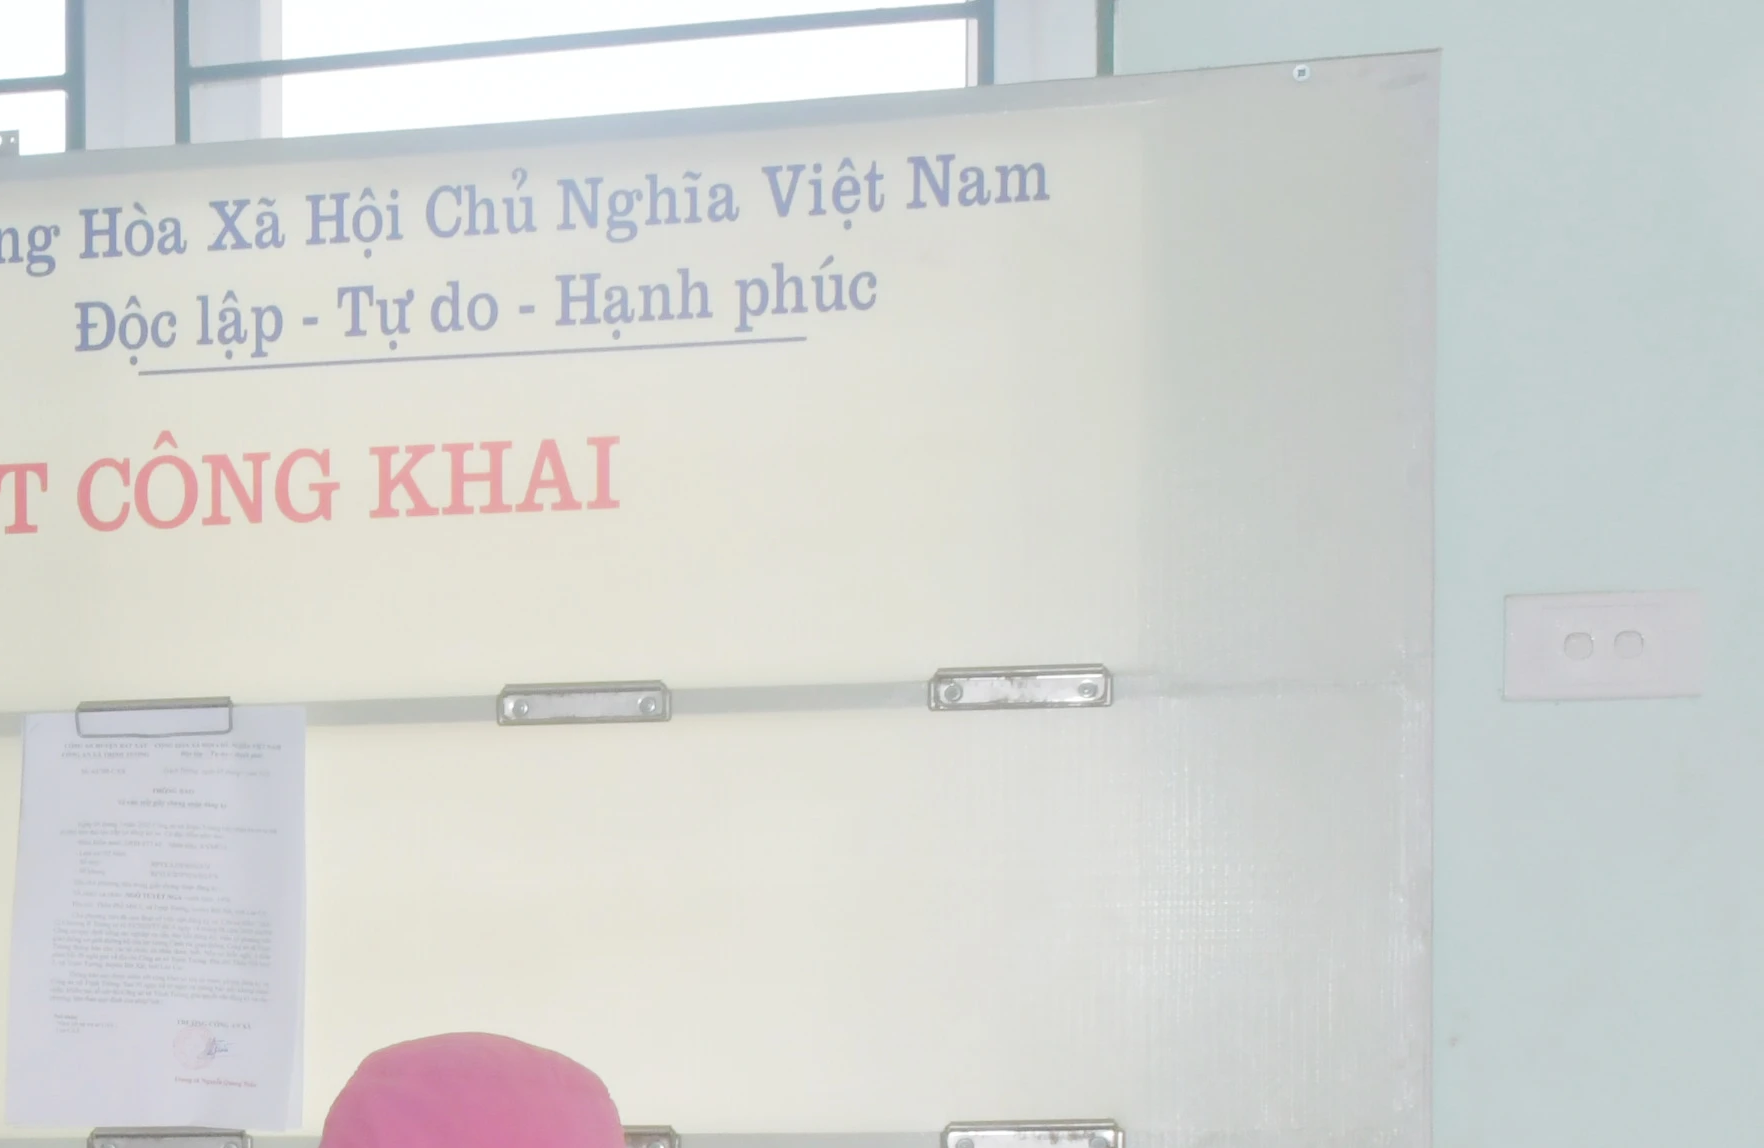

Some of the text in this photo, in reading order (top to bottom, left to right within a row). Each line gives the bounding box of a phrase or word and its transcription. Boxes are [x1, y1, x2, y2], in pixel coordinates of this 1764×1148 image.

[79, 202, 187, 259] Hòa
[208, 198, 285, 251] Xã
[305, 187, 404, 258] Hội
[426, 167, 537, 239] Chủ
[557, 171, 739, 243] Nghĩa
[762, 157, 885, 230] Việt
[906, 154, 1050, 209] Nam
[75, 255, 877, 365] Độc lập - Tự do - Hạnh phúc
[77, 430, 340, 532] CÔNG
[369, 435, 620, 518] KHAI
